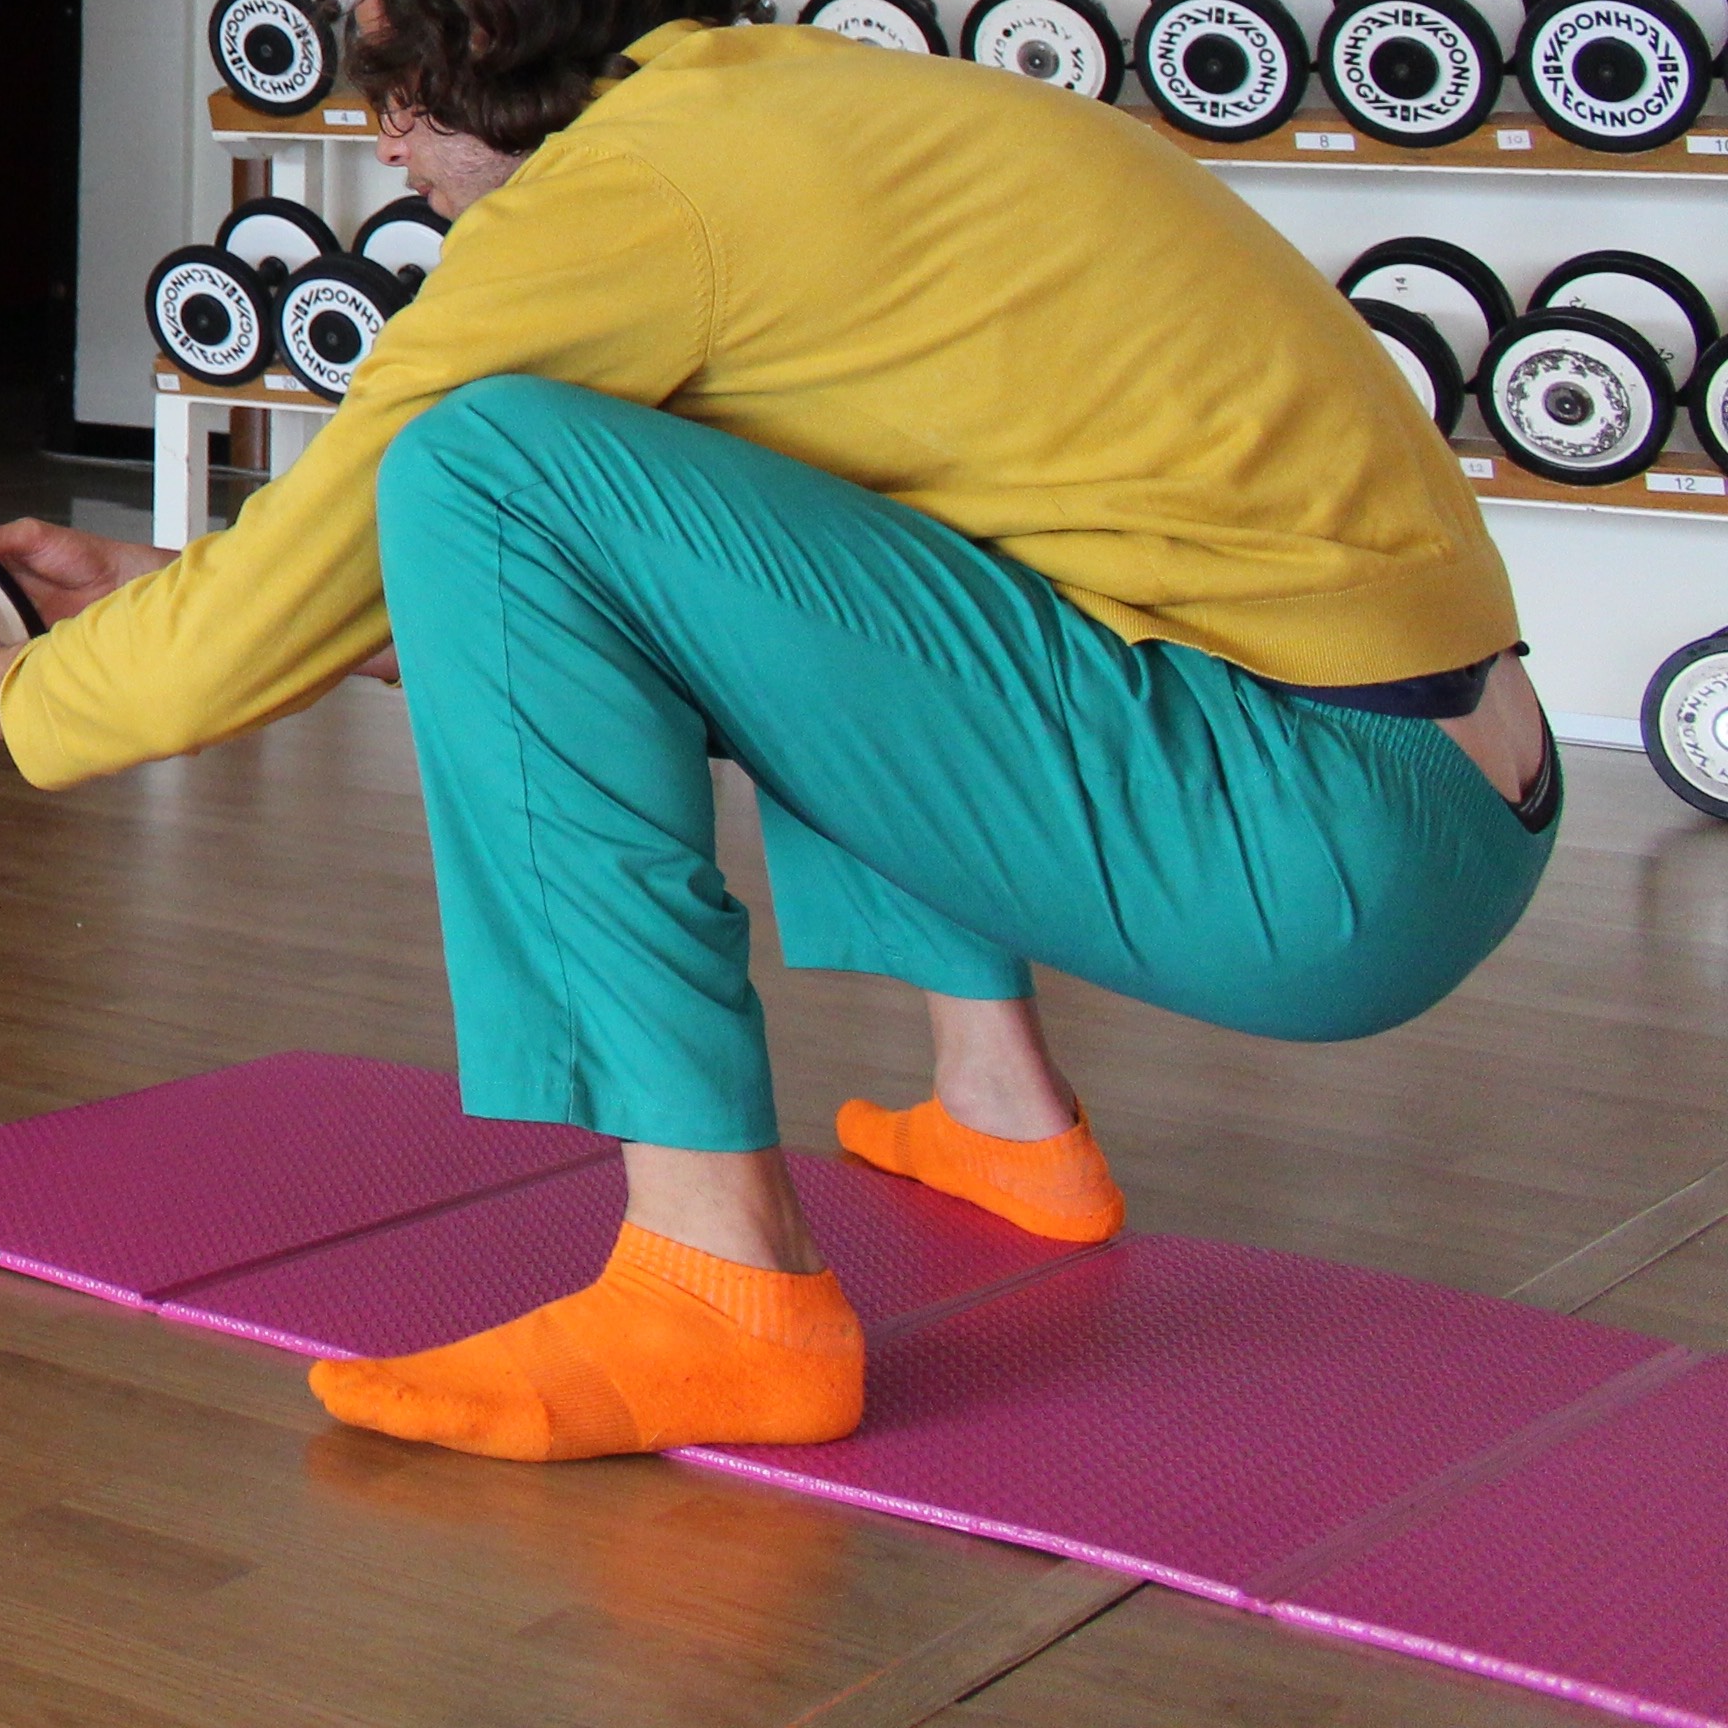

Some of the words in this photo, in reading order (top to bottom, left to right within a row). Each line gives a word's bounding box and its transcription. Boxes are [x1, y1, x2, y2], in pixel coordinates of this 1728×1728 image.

[1545, 75, 1680, 128] TECHNOGYM
[1319, 134, 1330, 148] 8
[1395, 276, 1408, 293] 14
[1674, 476, 1697, 492] 12
